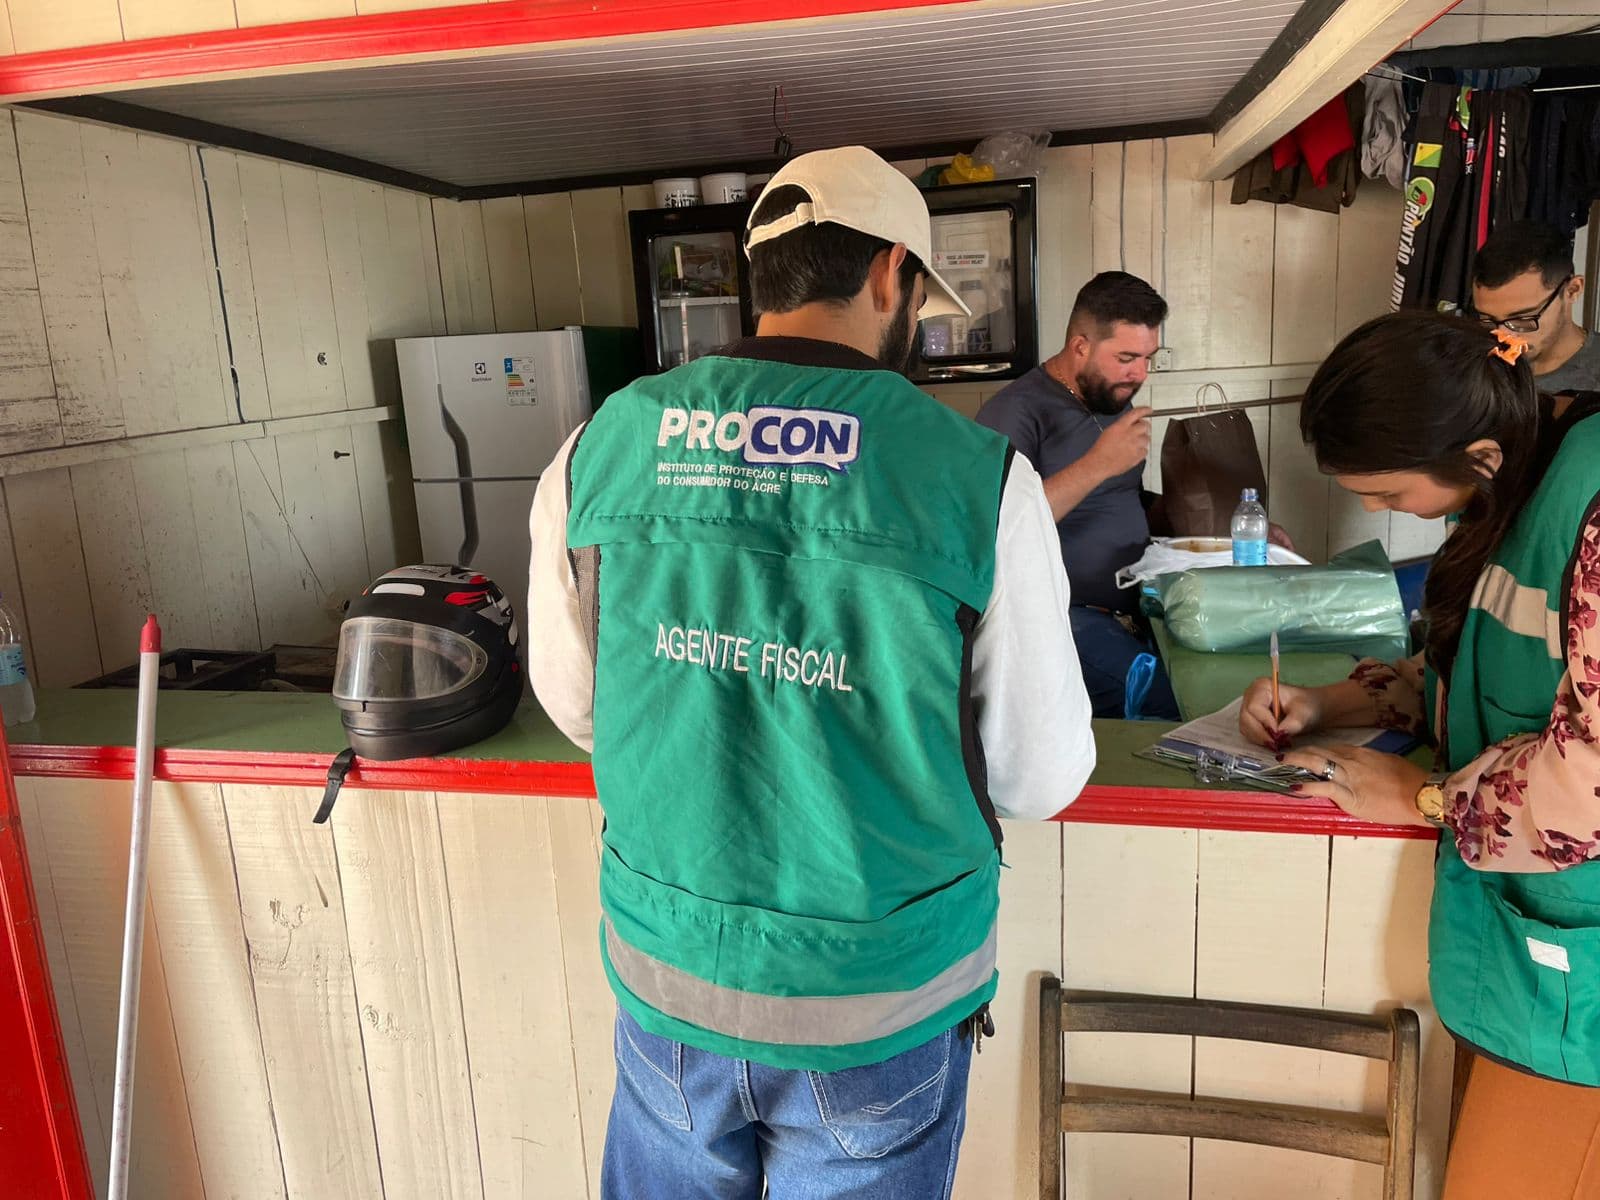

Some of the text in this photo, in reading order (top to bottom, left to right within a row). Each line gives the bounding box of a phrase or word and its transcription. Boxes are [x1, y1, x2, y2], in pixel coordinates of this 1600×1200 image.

[657, 407, 851, 455] PROCON
[657, 462, 702, 473] INSTITUTO
[704, 464, 716, 474] DE
[780, 472, 787, 482] E
[790, 472, 829, 487] DEFESA
[657, 475, 781, 494] DO CONSUMIDOR DO ACRE
[655, 623, 853, 692] AGENTE FISCAL
